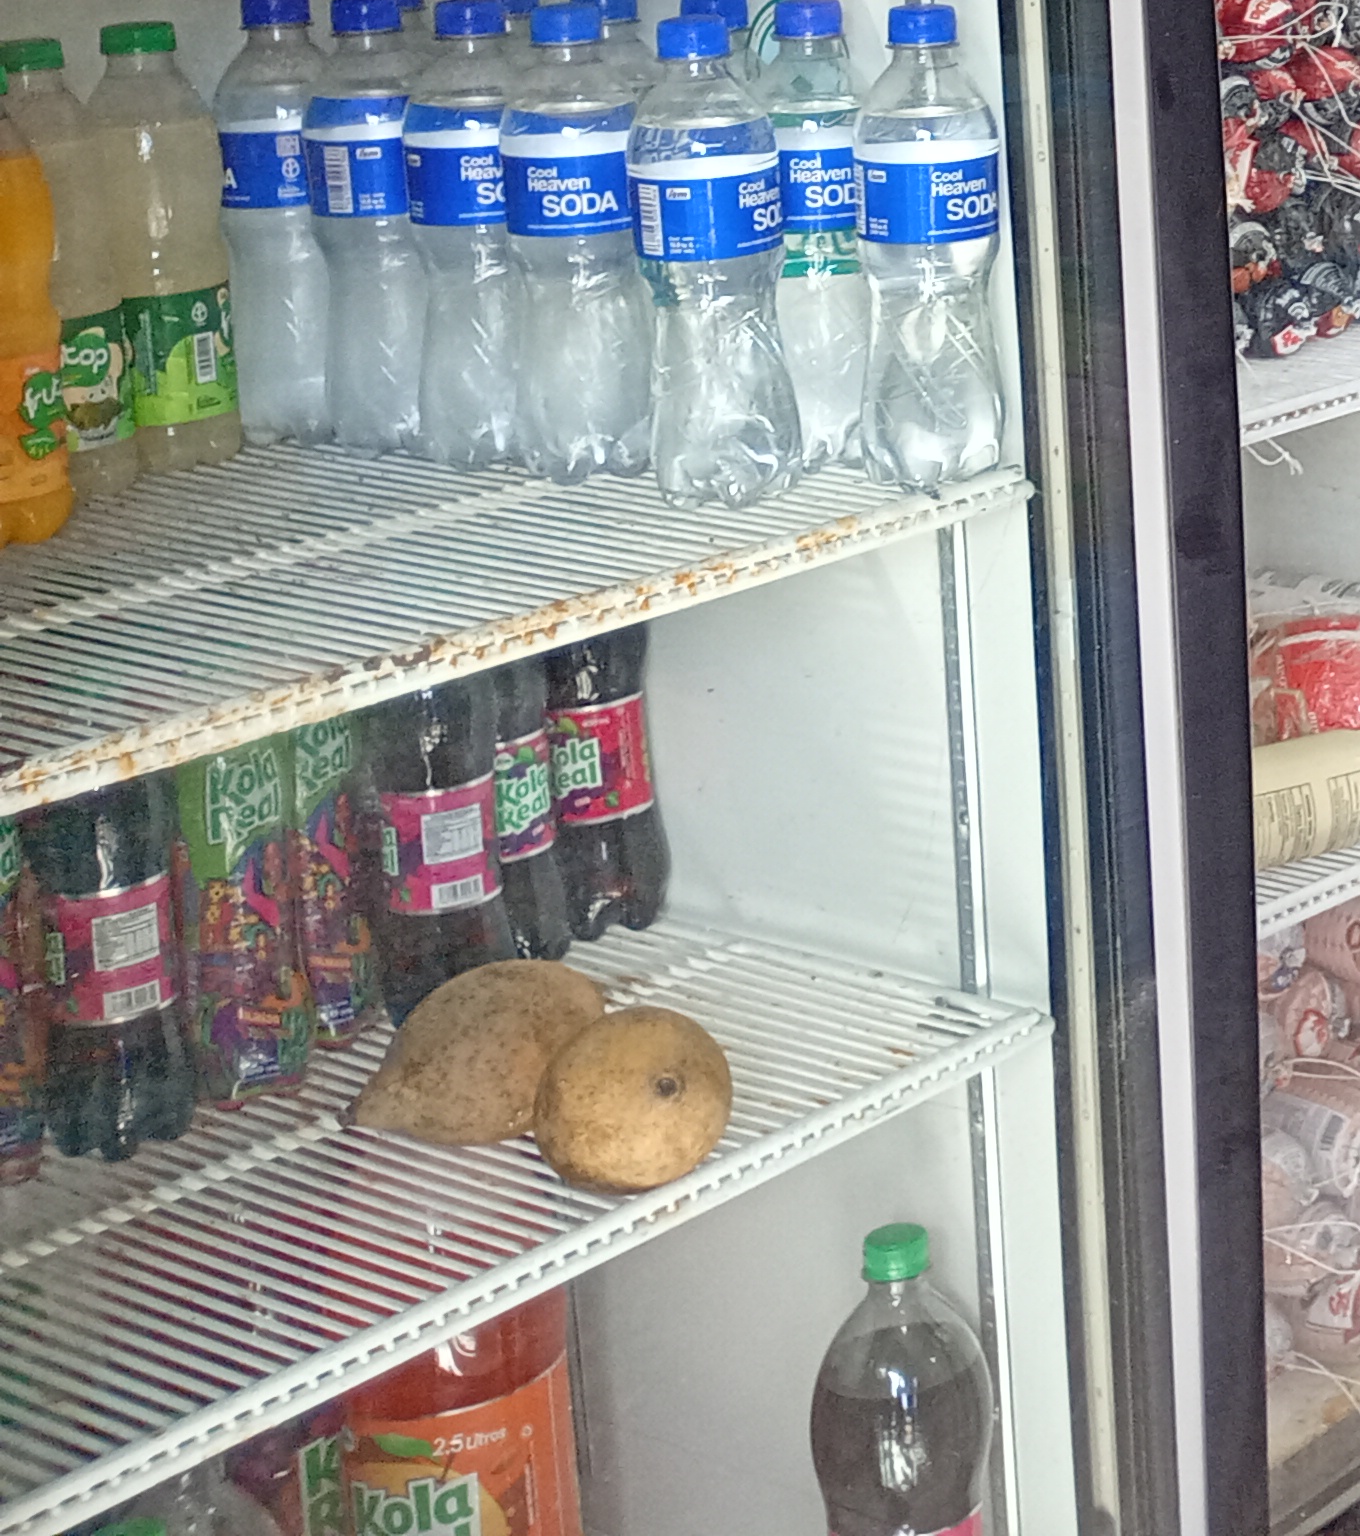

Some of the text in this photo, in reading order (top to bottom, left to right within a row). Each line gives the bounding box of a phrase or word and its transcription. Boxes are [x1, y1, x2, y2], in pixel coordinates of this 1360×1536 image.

[460, 155, 494, 166] Cool
[789, 153, 822, 170] Cool
[460, 166, 504, 181] Heav
[526, 166, 558, 178] Cool
[789, 167, 852, 183] Heaven
[931, 169, 963, 182] Cool
[527, 176, 592, 192] Heaven
[738, 180, 766, 194] Cool
[931, 177, 987, 197] Heaven
[541, 190, 619, 218] SODA
[804, 183, 858, 208] SOD
[60, 343, 108, 375] top
[208, 748, 278, 806] Kola
[496, 764, 549, 810] Kola
[432, 1432, 465, 1457] 2.5
